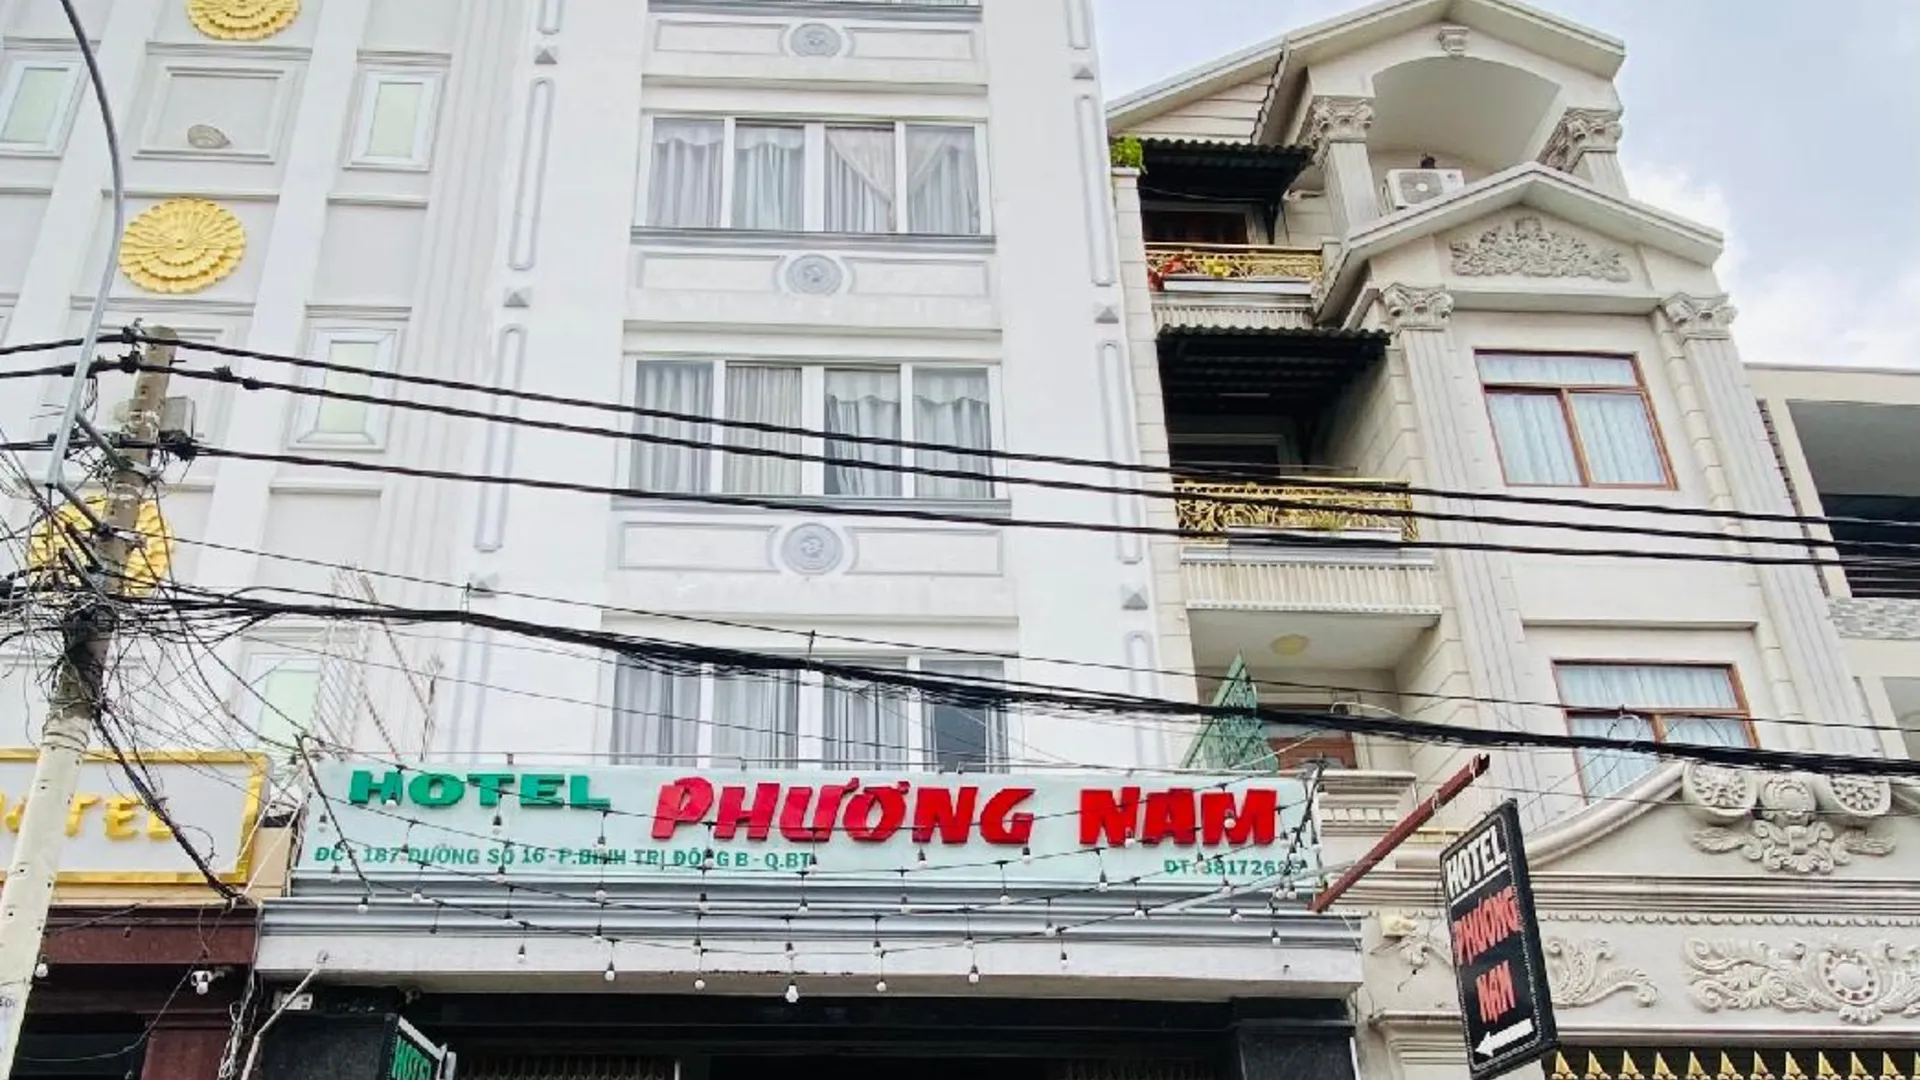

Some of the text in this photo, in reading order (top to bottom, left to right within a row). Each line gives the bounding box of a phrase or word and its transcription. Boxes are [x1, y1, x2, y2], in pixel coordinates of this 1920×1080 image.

[0, 793, 172, 840] TEL
[349, 770, 611, 808] HOTEL
[652, 777, 1277, 847] PHƯƠNG NAM
[673, 847, 729, 866] ĐÔG
[1445, 825, 1506, 900] HOTEL
[1475, 960, 1516, 1023] NAM
